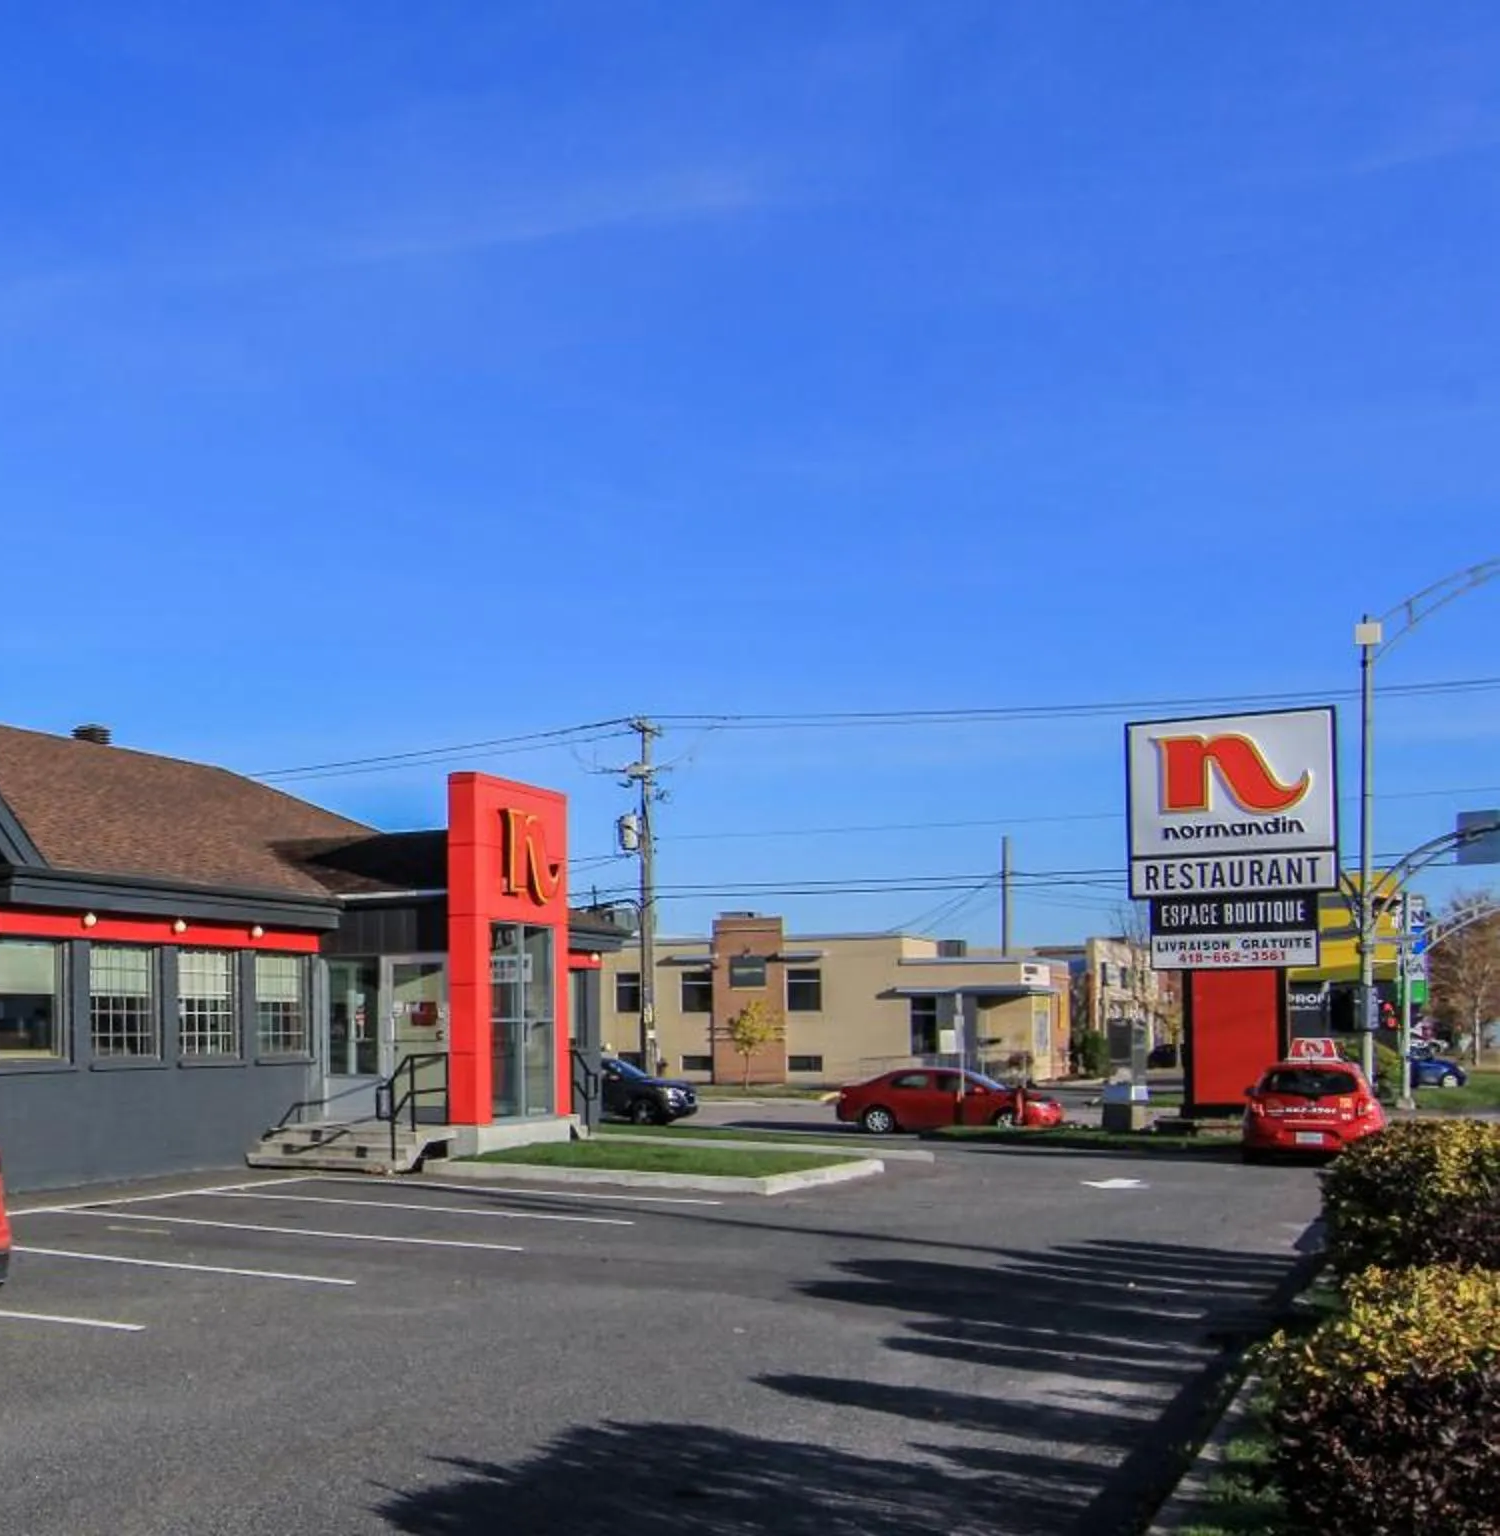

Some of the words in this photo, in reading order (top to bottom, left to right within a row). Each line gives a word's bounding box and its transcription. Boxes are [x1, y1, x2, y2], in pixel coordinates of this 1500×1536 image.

[1163, 815, 1306, 841] normandin
[1144, 856, 1321, 892] RESTAURANT
[1160, 902, 1219, 927] ESPACE
[1223, 900, 1306, 924] BOUTIQUE
[1156, 940, 1231, 953] LIVRAISON
[1240, 937, 1313, 950] GRATUITE
[1178, 950, 1287, 964] 418-662-3561
